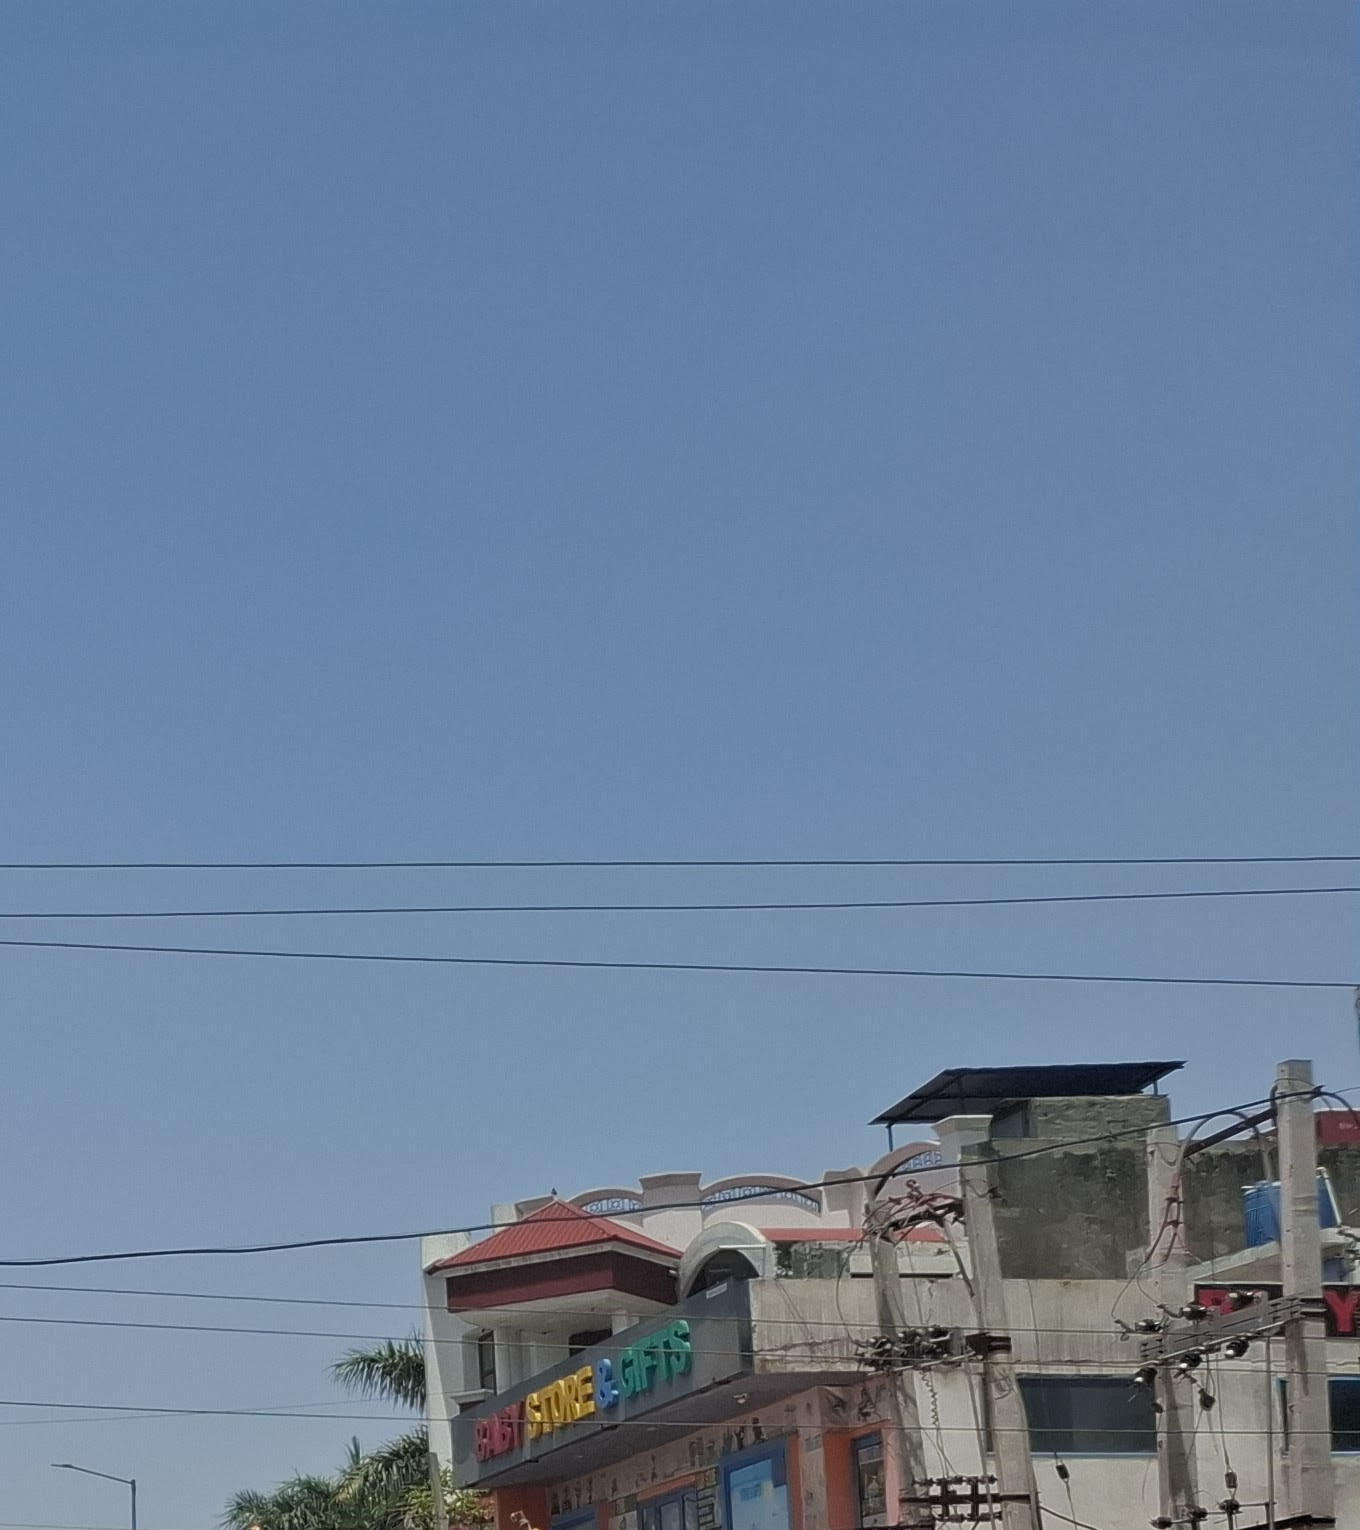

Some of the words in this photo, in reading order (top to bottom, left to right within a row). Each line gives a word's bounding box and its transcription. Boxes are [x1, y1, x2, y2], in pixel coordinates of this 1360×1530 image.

[527, 1365, 596, 1440] STORE
[596, 1358, 619, 1409] &
[620, 1319, 692, 1399] GIFTS
